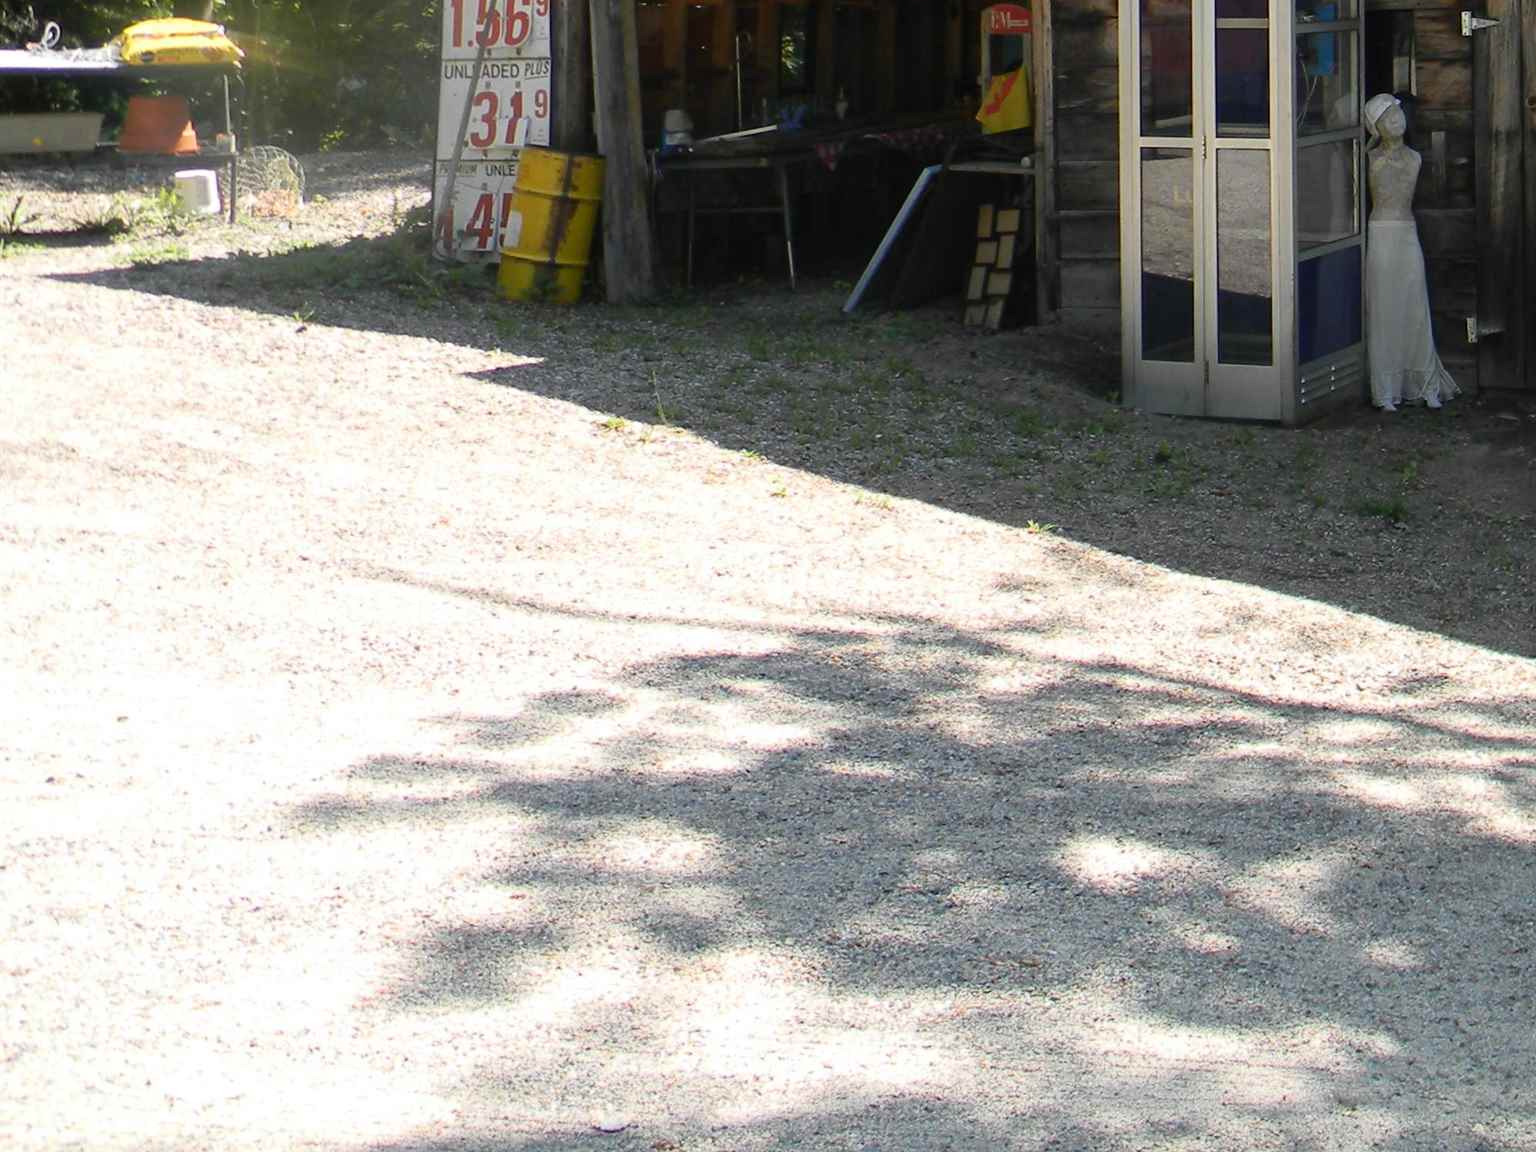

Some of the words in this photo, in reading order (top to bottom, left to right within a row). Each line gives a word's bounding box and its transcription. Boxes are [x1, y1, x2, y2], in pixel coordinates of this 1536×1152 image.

[444, 63, 520, 79] UNLADED
[523, 59, 550, 78] PLUS
[485, 164, 516, 177] UNLE
